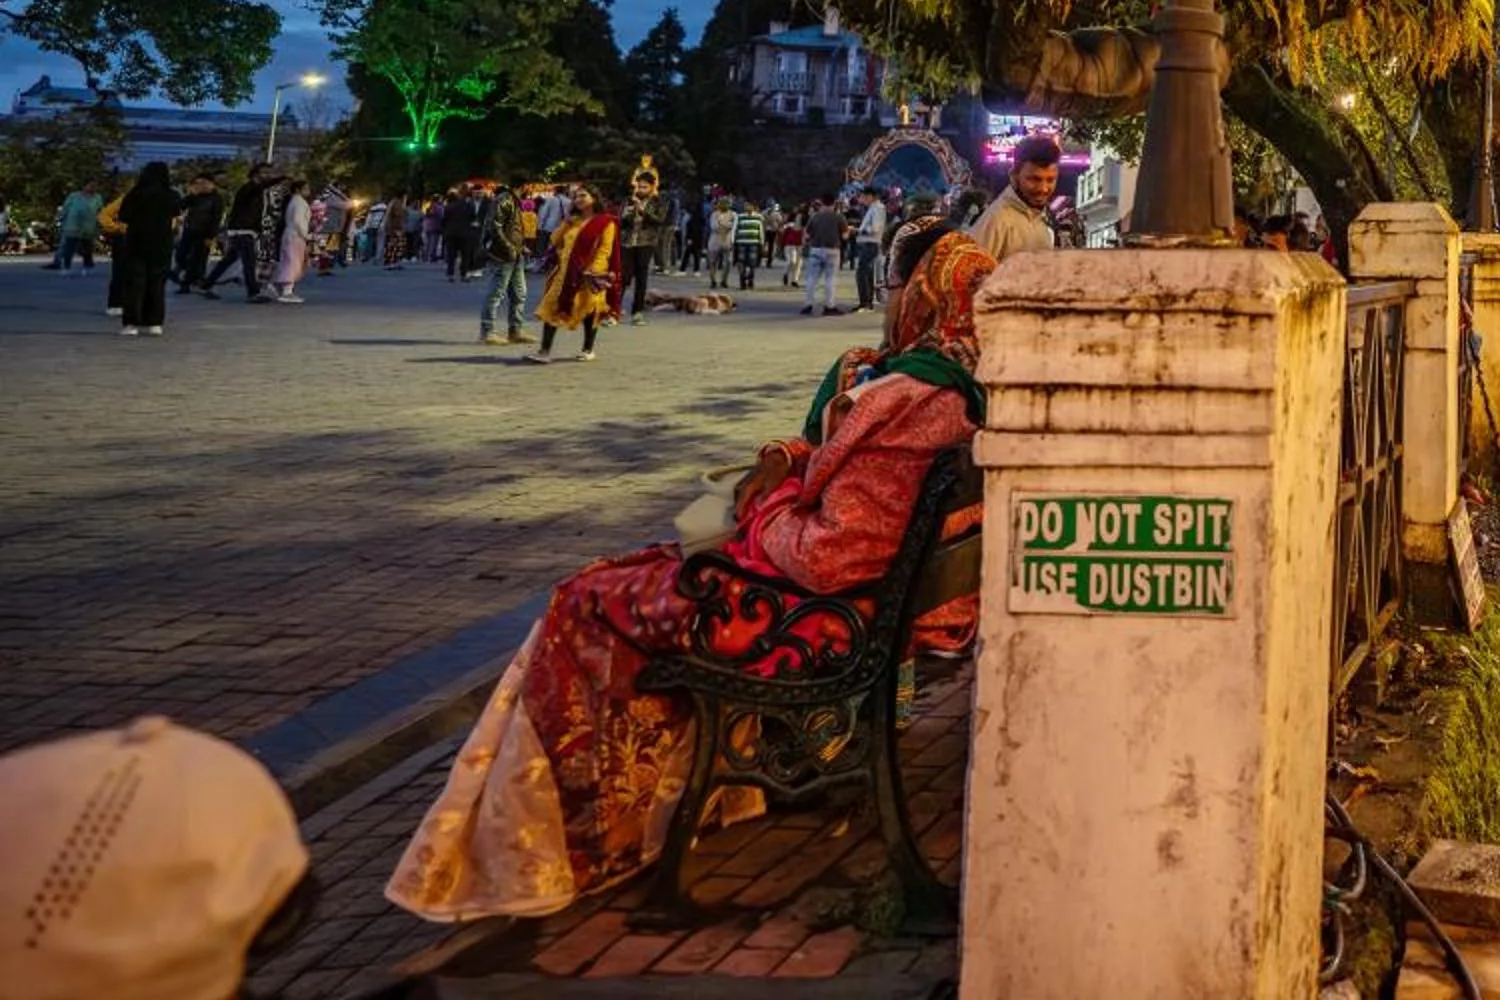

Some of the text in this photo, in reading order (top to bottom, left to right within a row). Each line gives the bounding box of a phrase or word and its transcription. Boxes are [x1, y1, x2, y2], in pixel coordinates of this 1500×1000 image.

[1021, 501, 1228, 546] DO NOT SPIT
[1020, 562, 1227, 607] USE DUSTBIN
